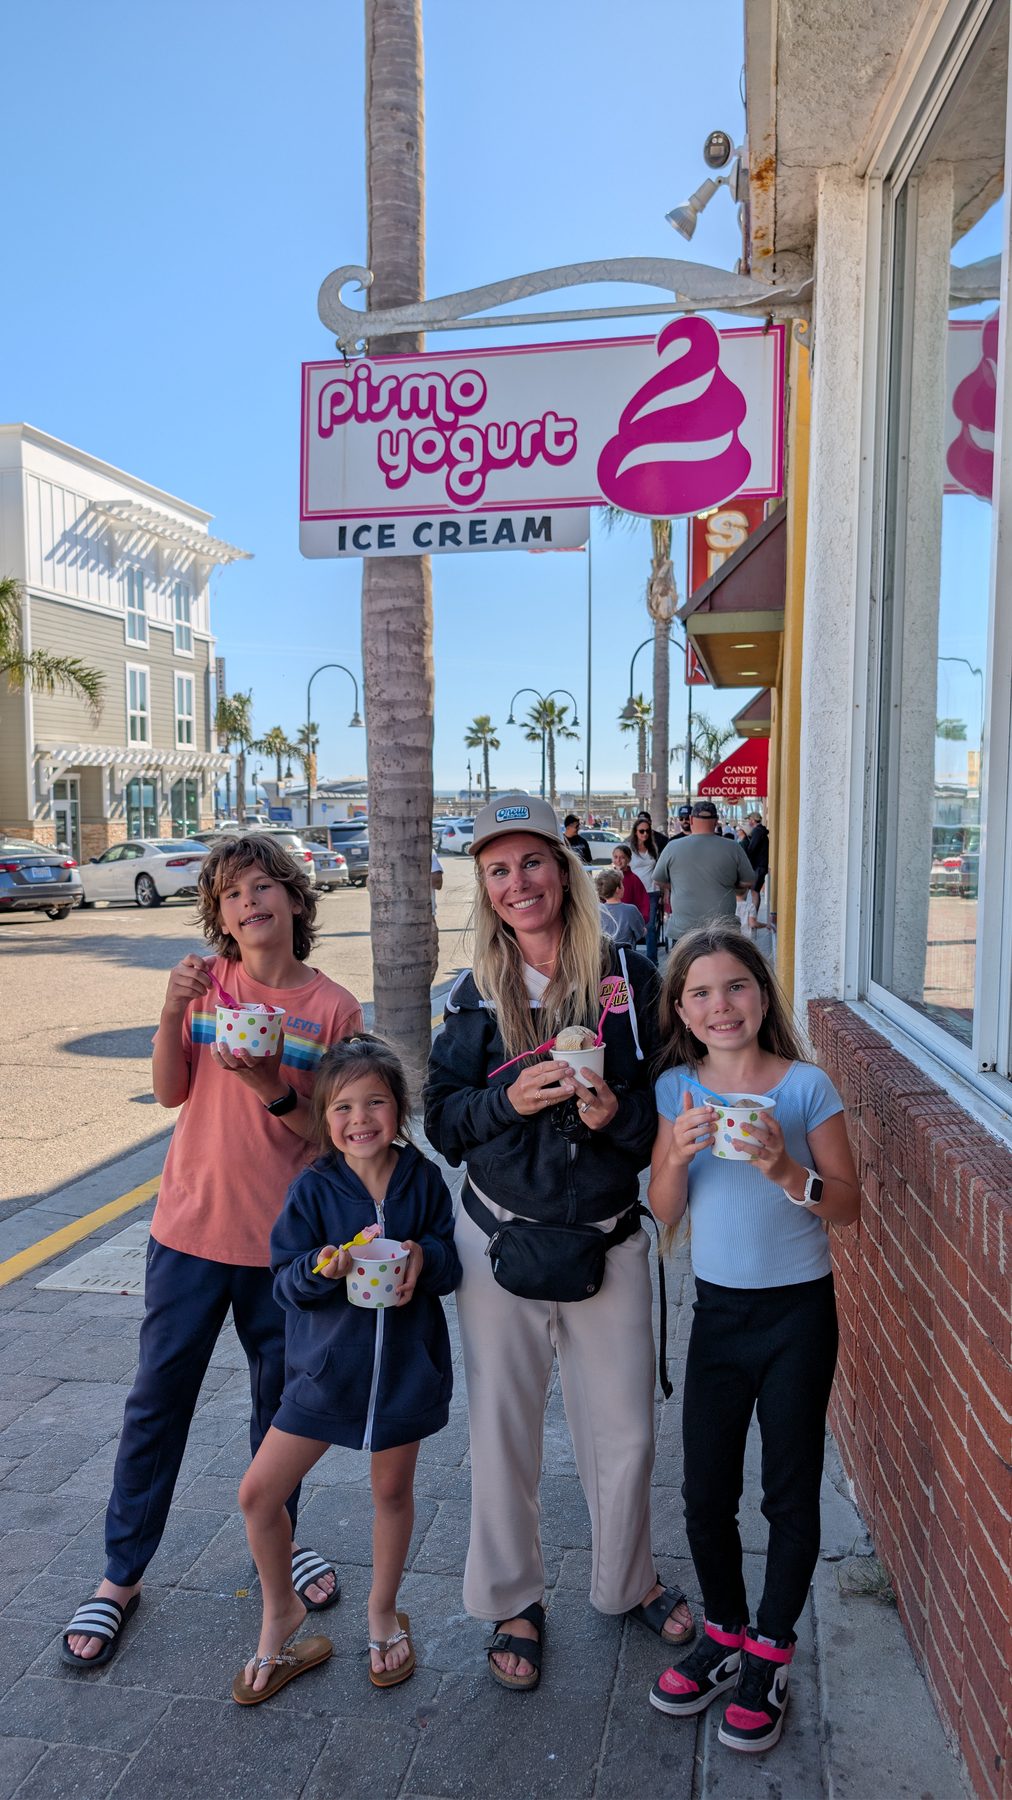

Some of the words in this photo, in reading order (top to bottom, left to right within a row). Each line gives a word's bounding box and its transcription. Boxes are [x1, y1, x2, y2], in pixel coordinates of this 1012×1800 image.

[318, 364, 487, 438] pismo
[378, 411, 577, 505] yogurt
[338, 524, 396, 551] ICE
[412, 516, 552, 548] CREAM
[721, 776, 757, 785] COFFEE
[724, 765, 758, 774] CANDY
[701, 786, 757, 795] CHOCOLATE
